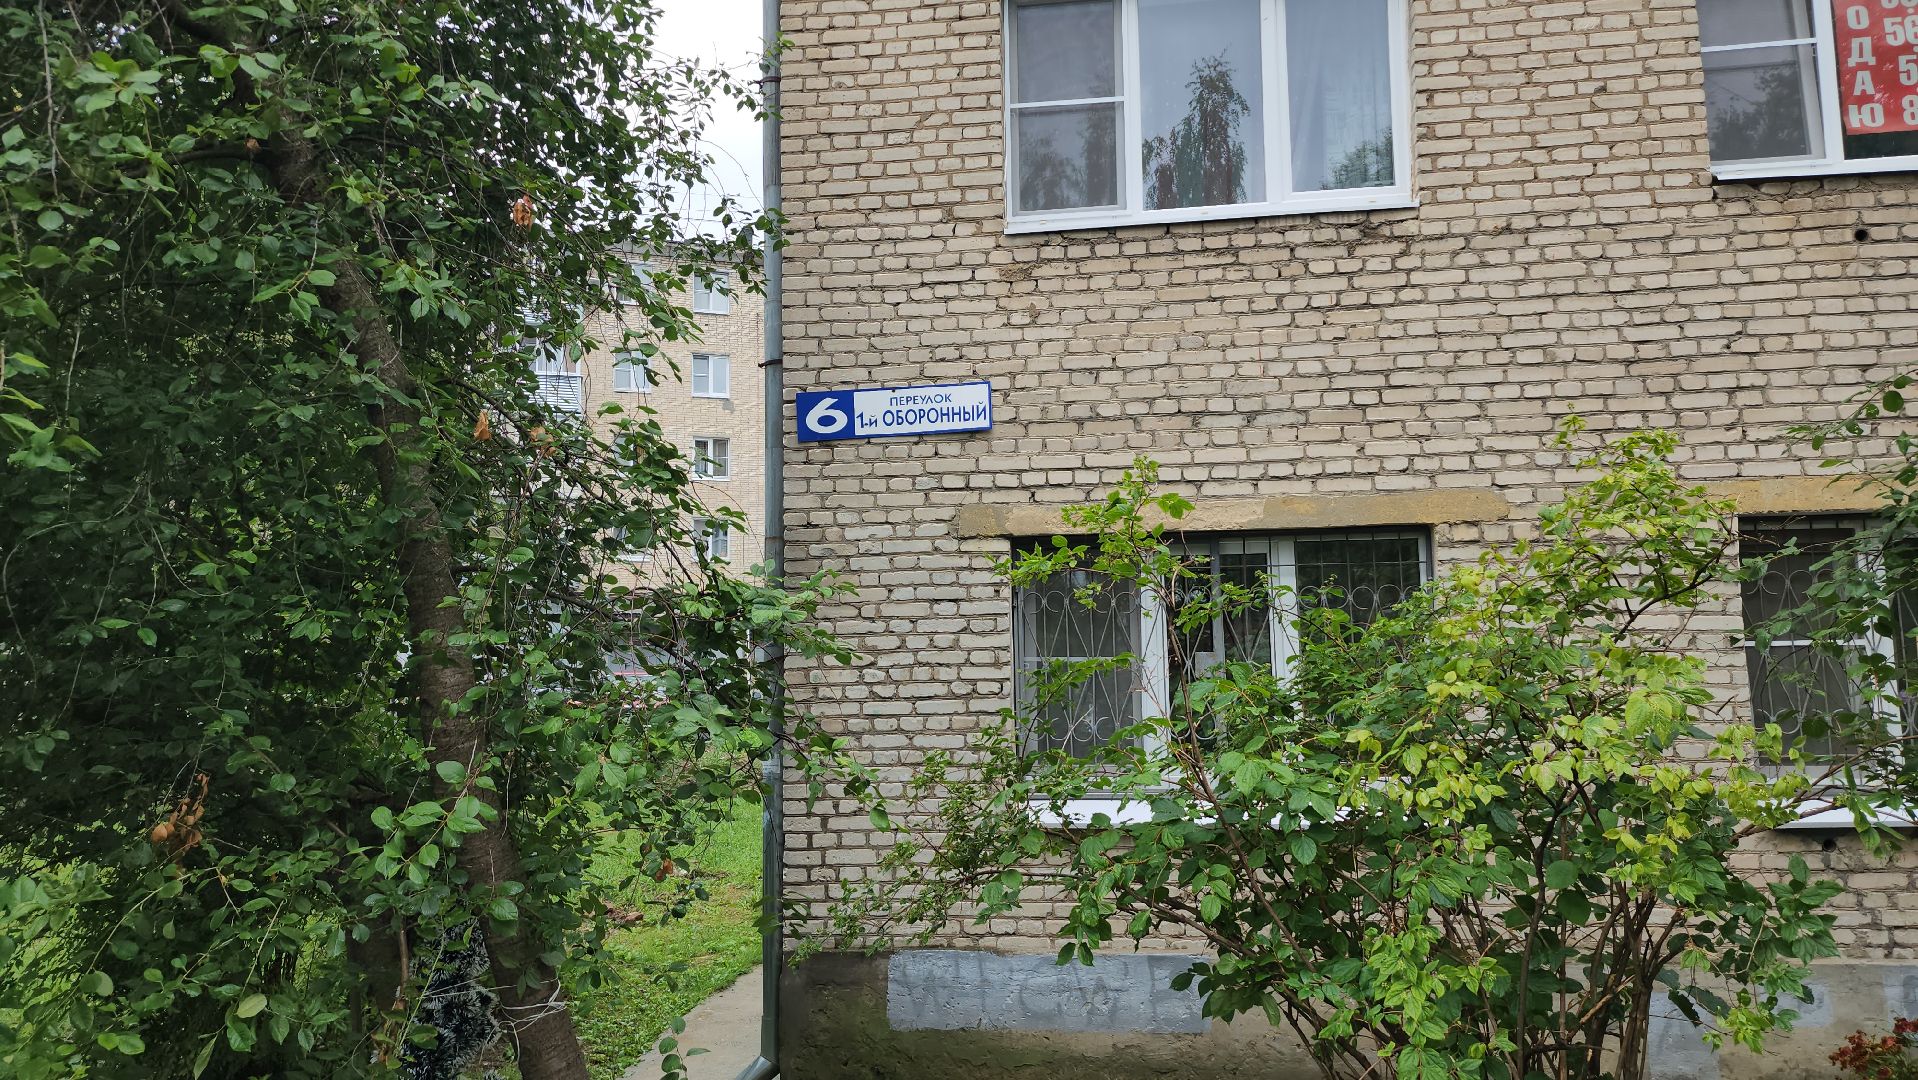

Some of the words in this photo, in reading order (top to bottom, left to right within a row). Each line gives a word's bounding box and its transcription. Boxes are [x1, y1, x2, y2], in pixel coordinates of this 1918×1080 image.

[889, 393, 952, 407] ПЕРЕУЛОК
[805, 397, 848, 434] 6
[882, 401, 987, 427] ОБОРОННЫЙ
